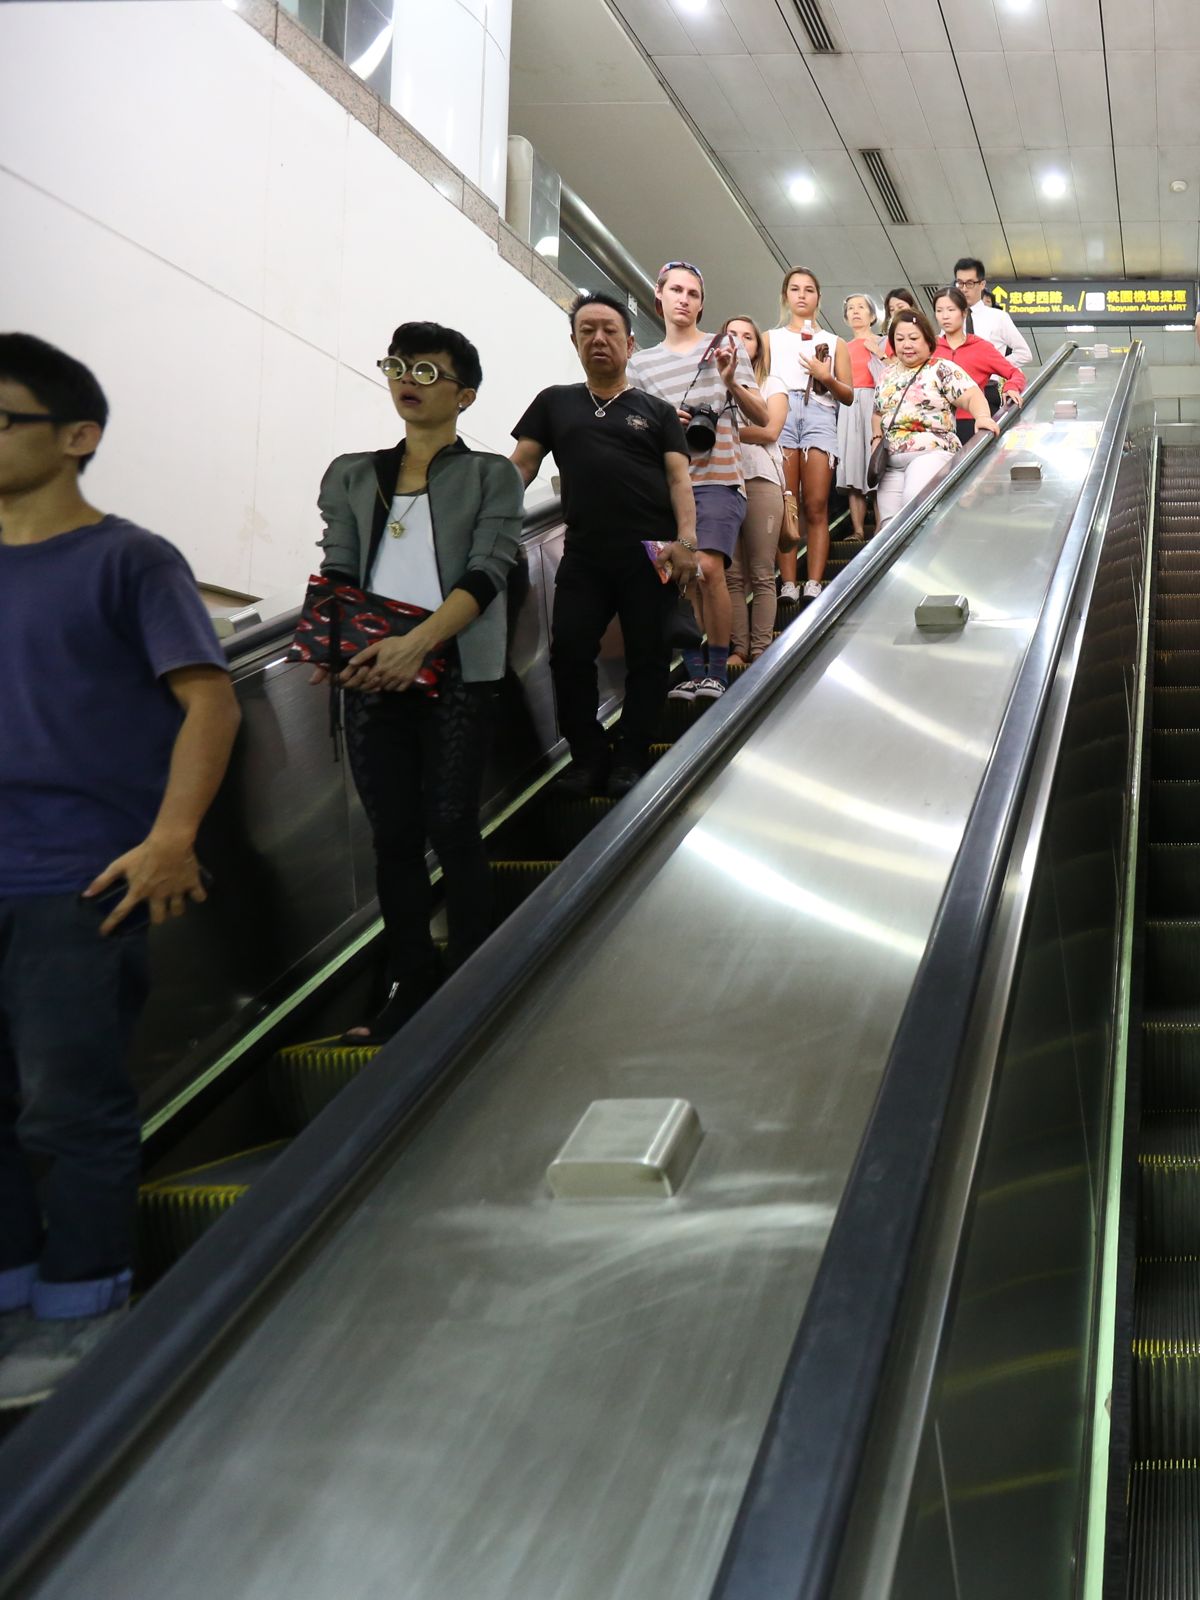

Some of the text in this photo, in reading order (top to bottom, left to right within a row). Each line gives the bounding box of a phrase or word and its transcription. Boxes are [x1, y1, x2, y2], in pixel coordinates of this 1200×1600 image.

[1009, 291, 1063, 304] 忠孝西路
[1106, 290, 1187, 303] 桃園機場捷運
[1009, 305, 1050, 314] Zhongxiao
[1106, 304, 1139, 312] Taoyuan
[1140, 304, 1167, 312] Airport
